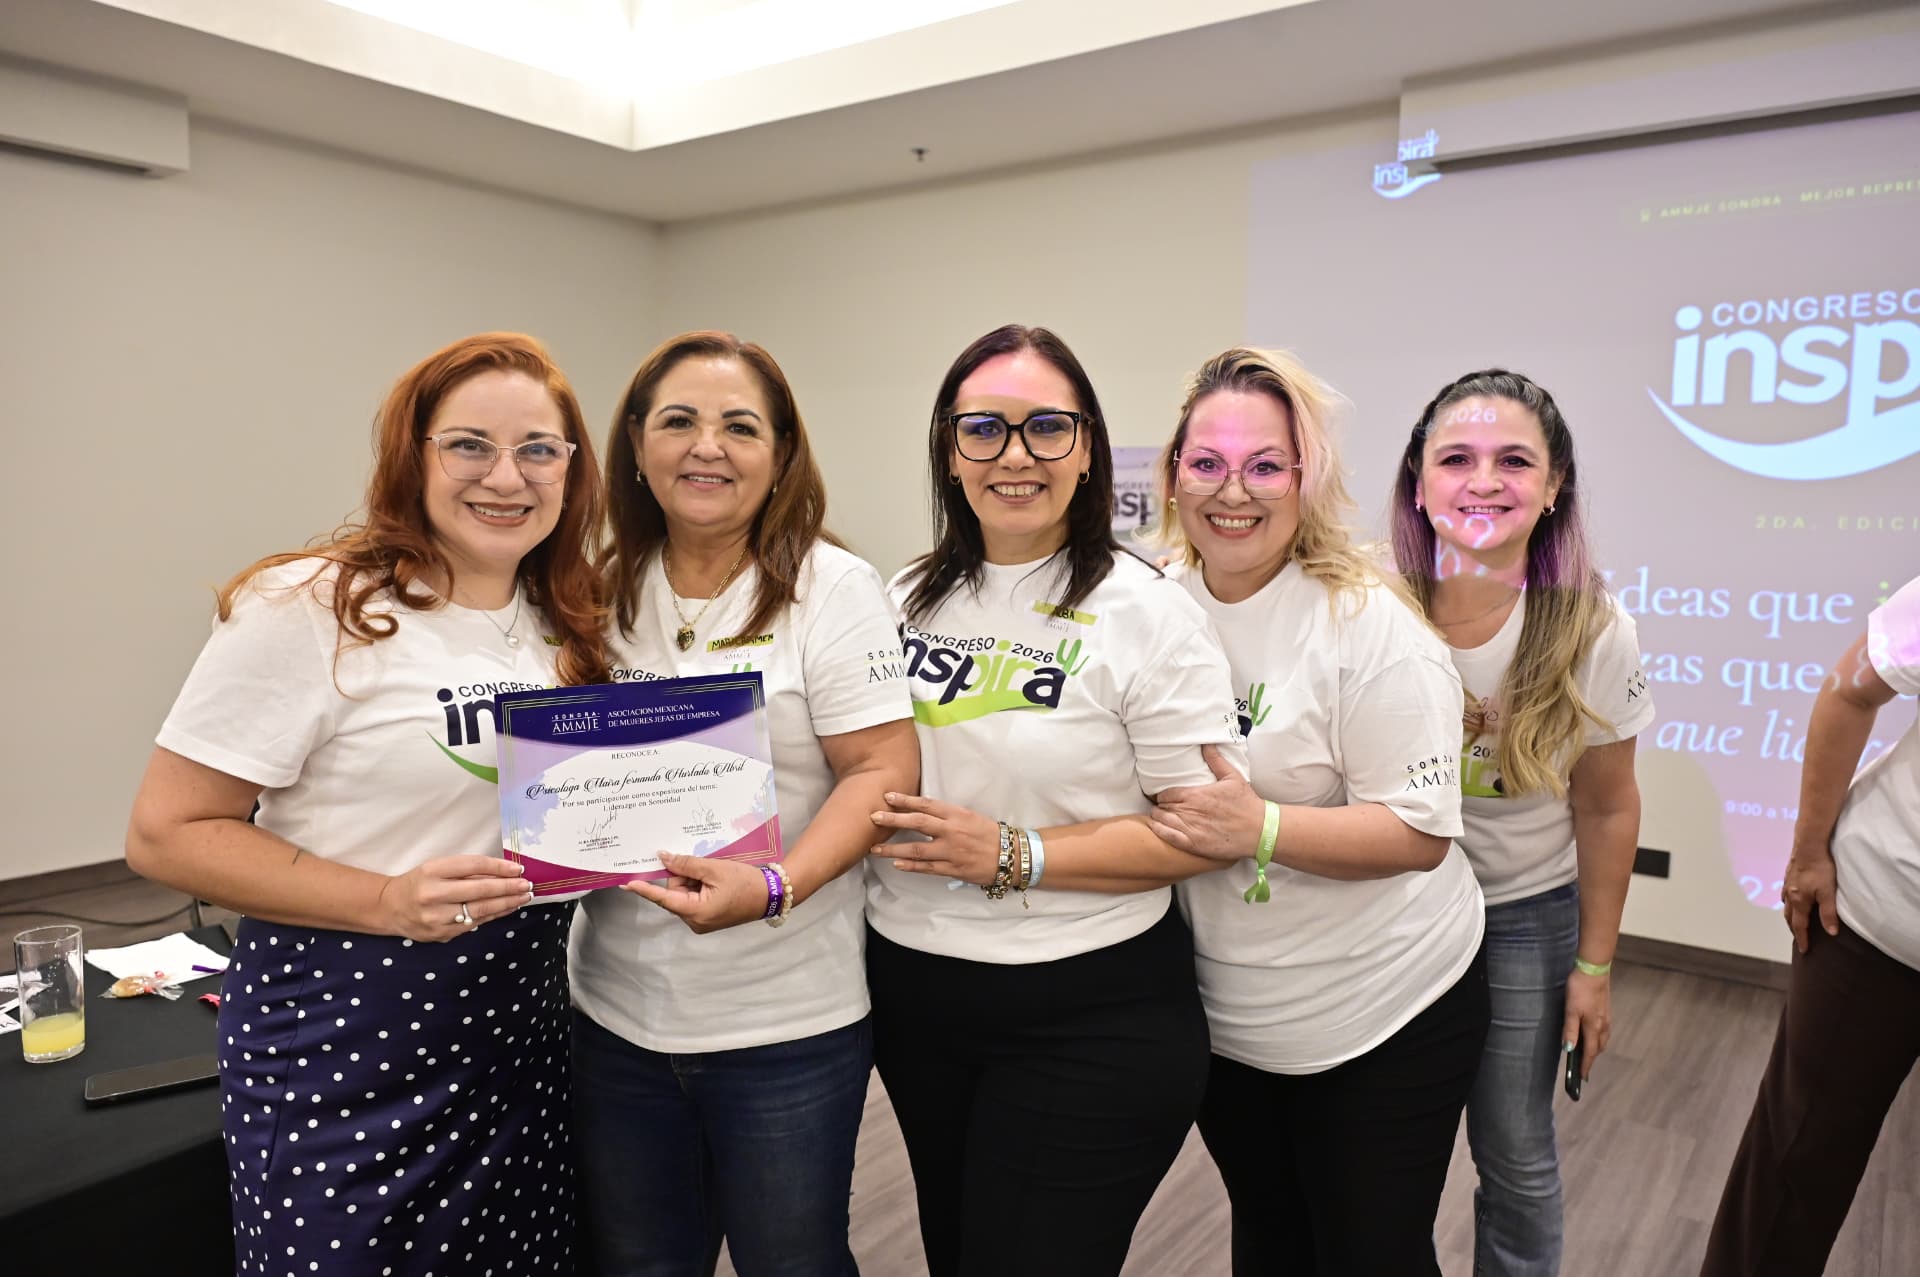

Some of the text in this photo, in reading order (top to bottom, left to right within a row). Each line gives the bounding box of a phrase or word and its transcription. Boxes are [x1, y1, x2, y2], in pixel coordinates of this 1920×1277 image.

[1602, 566, 1731, 618] deas
[1748, 589, 1855, 639] que
[907, 625, 1054, 664] CONGRESO 2026
[1720, 657, 1825, 706] que
[553, 711, 600, 721] SONORA
[608, 719, 619, 728] DE
[619, 715, 653, 726] MUJERES
[675, 713, 685, 721] DE
[687, 710, 720, 720] EMPRESA
[654, 703, 694, 714] MEXICANA
[562, 799, 574, 808] Por
[687, 784, 698, 792] del
